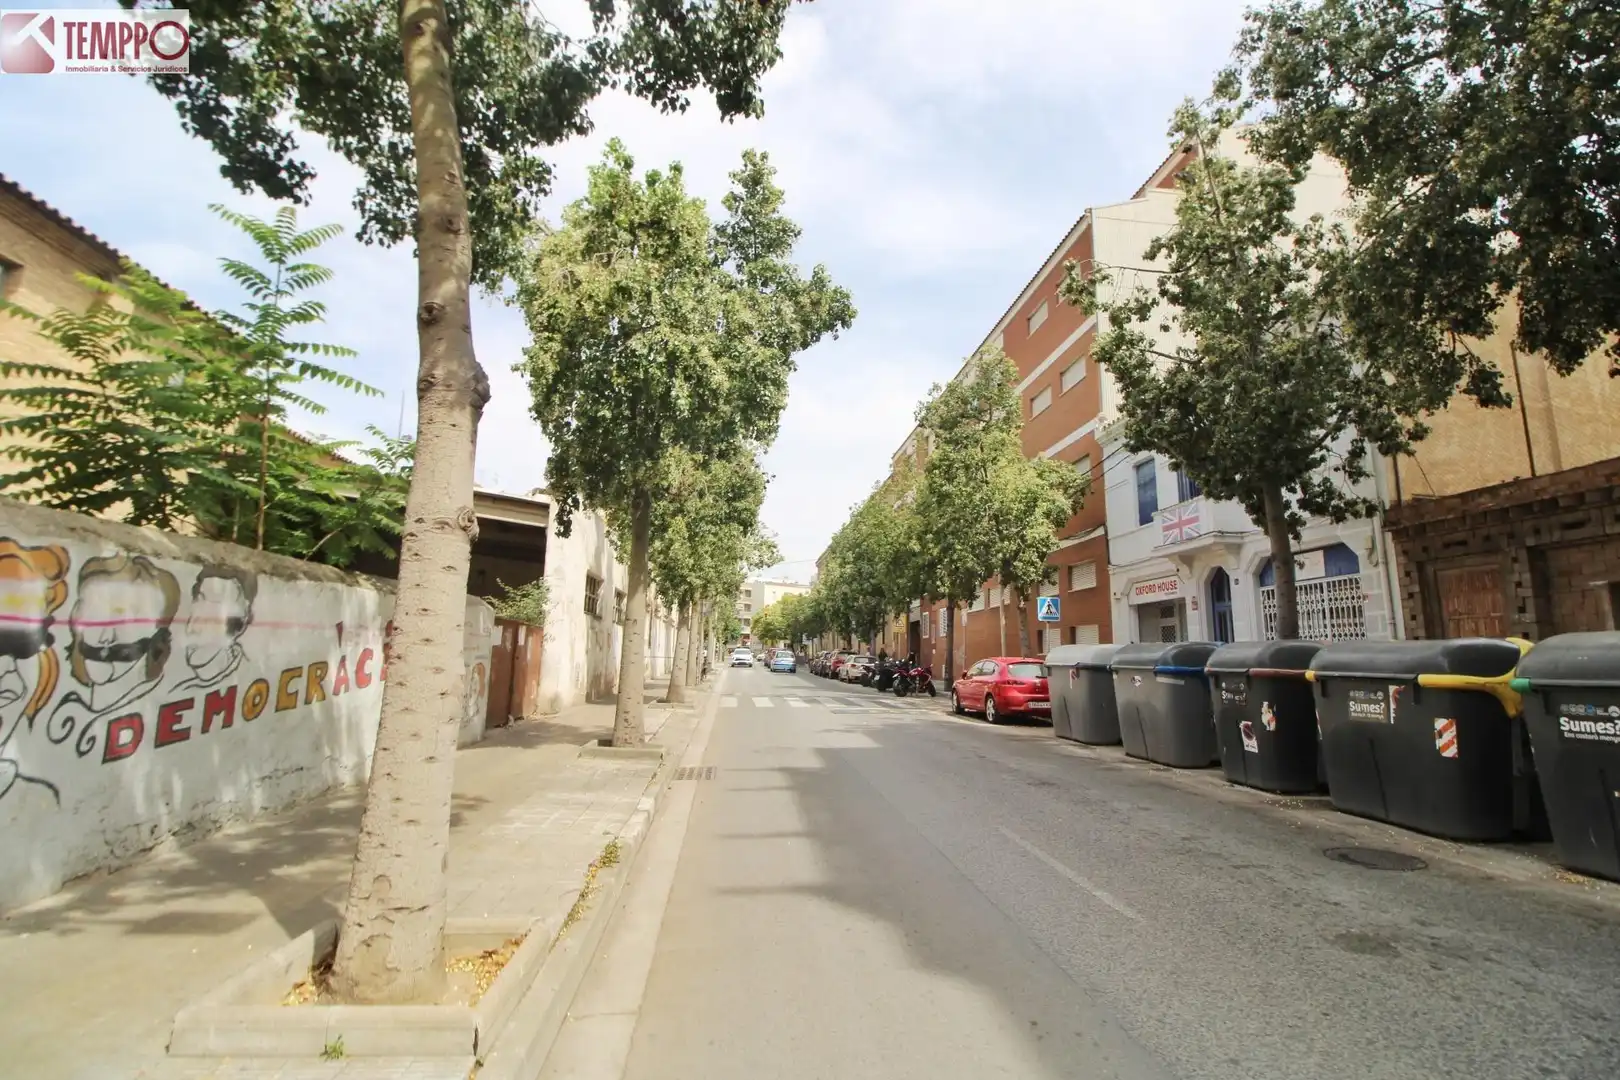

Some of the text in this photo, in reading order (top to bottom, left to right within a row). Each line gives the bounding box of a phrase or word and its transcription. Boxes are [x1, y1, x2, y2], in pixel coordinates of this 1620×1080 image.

[1135, 580, 1178, 596] OXFORD HOUSE
[1350, 700, 1385, 714] Sumes?
